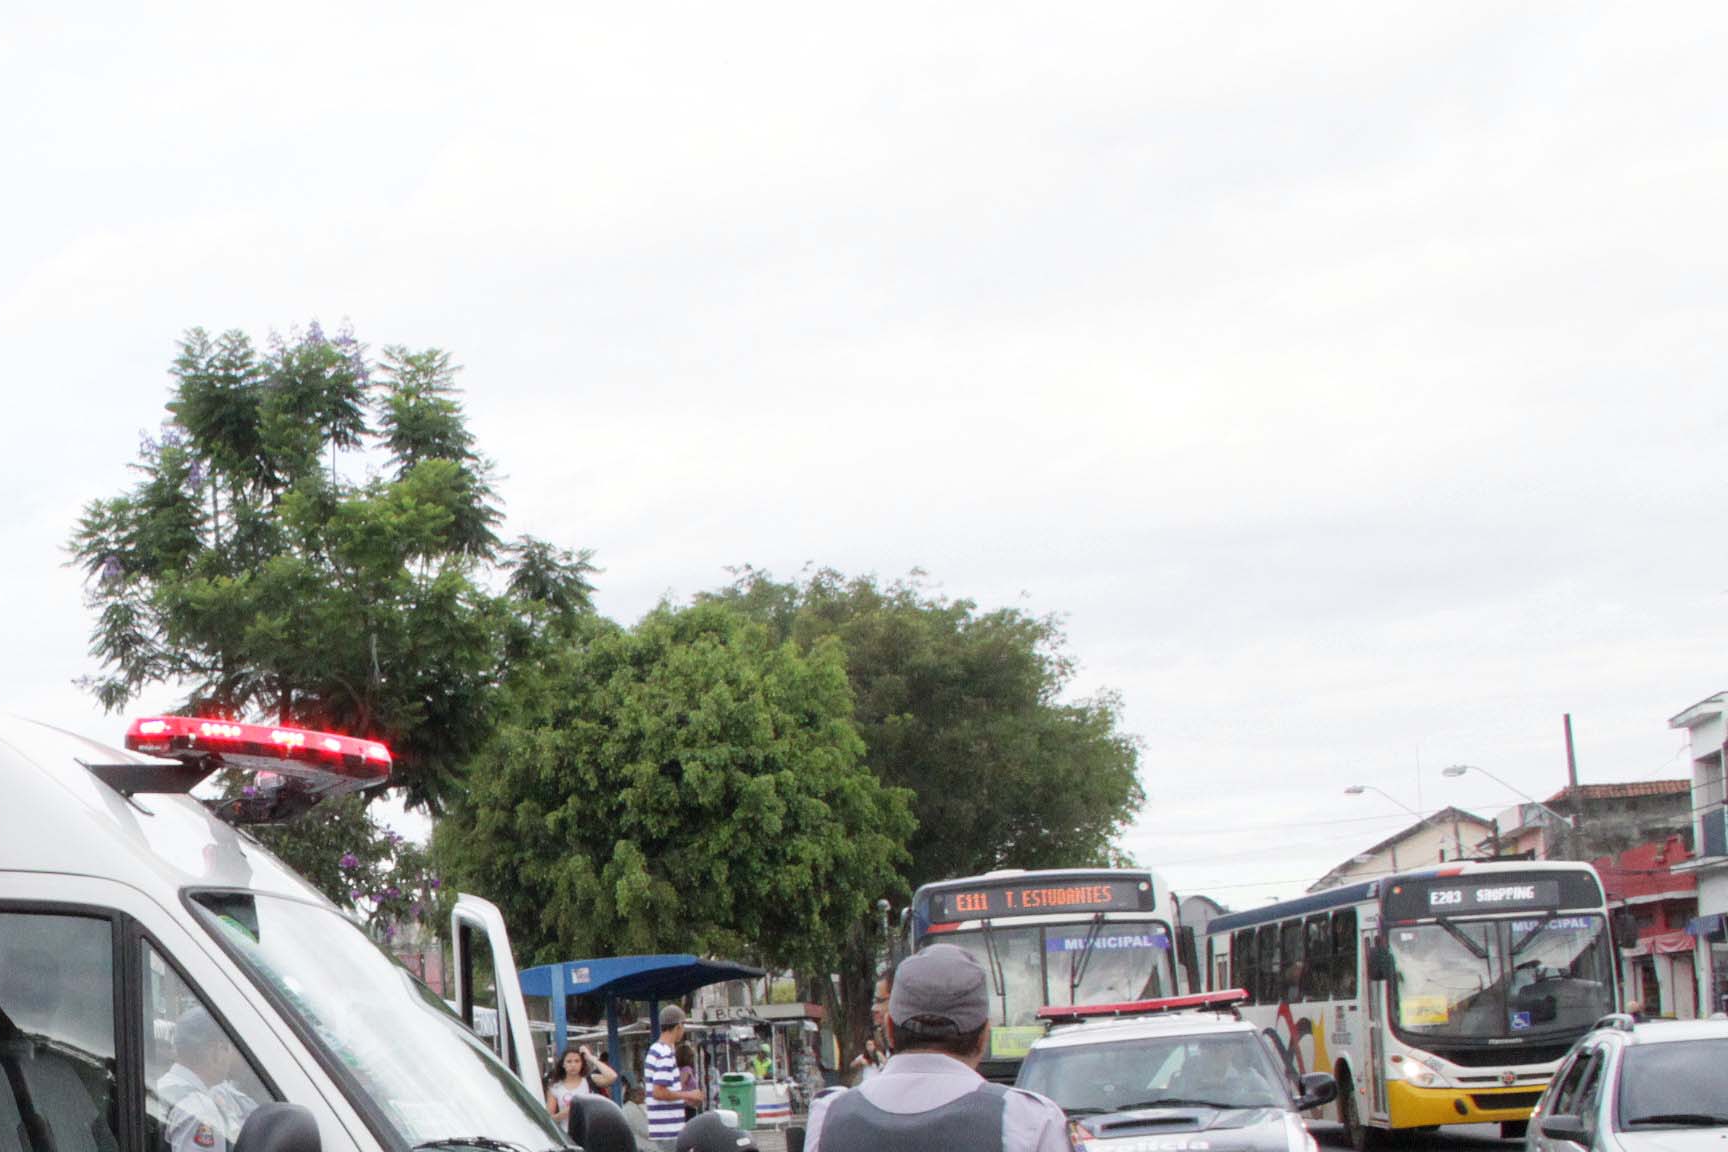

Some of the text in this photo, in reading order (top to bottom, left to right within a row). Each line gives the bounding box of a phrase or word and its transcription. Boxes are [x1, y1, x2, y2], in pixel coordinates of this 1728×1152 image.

[1023, 885, 1113, 907] ESTUDANTES
[1512, 917, 1588, 932] MUCIPAL
[1064, 935, 1152, 950] MUNICIPAL
